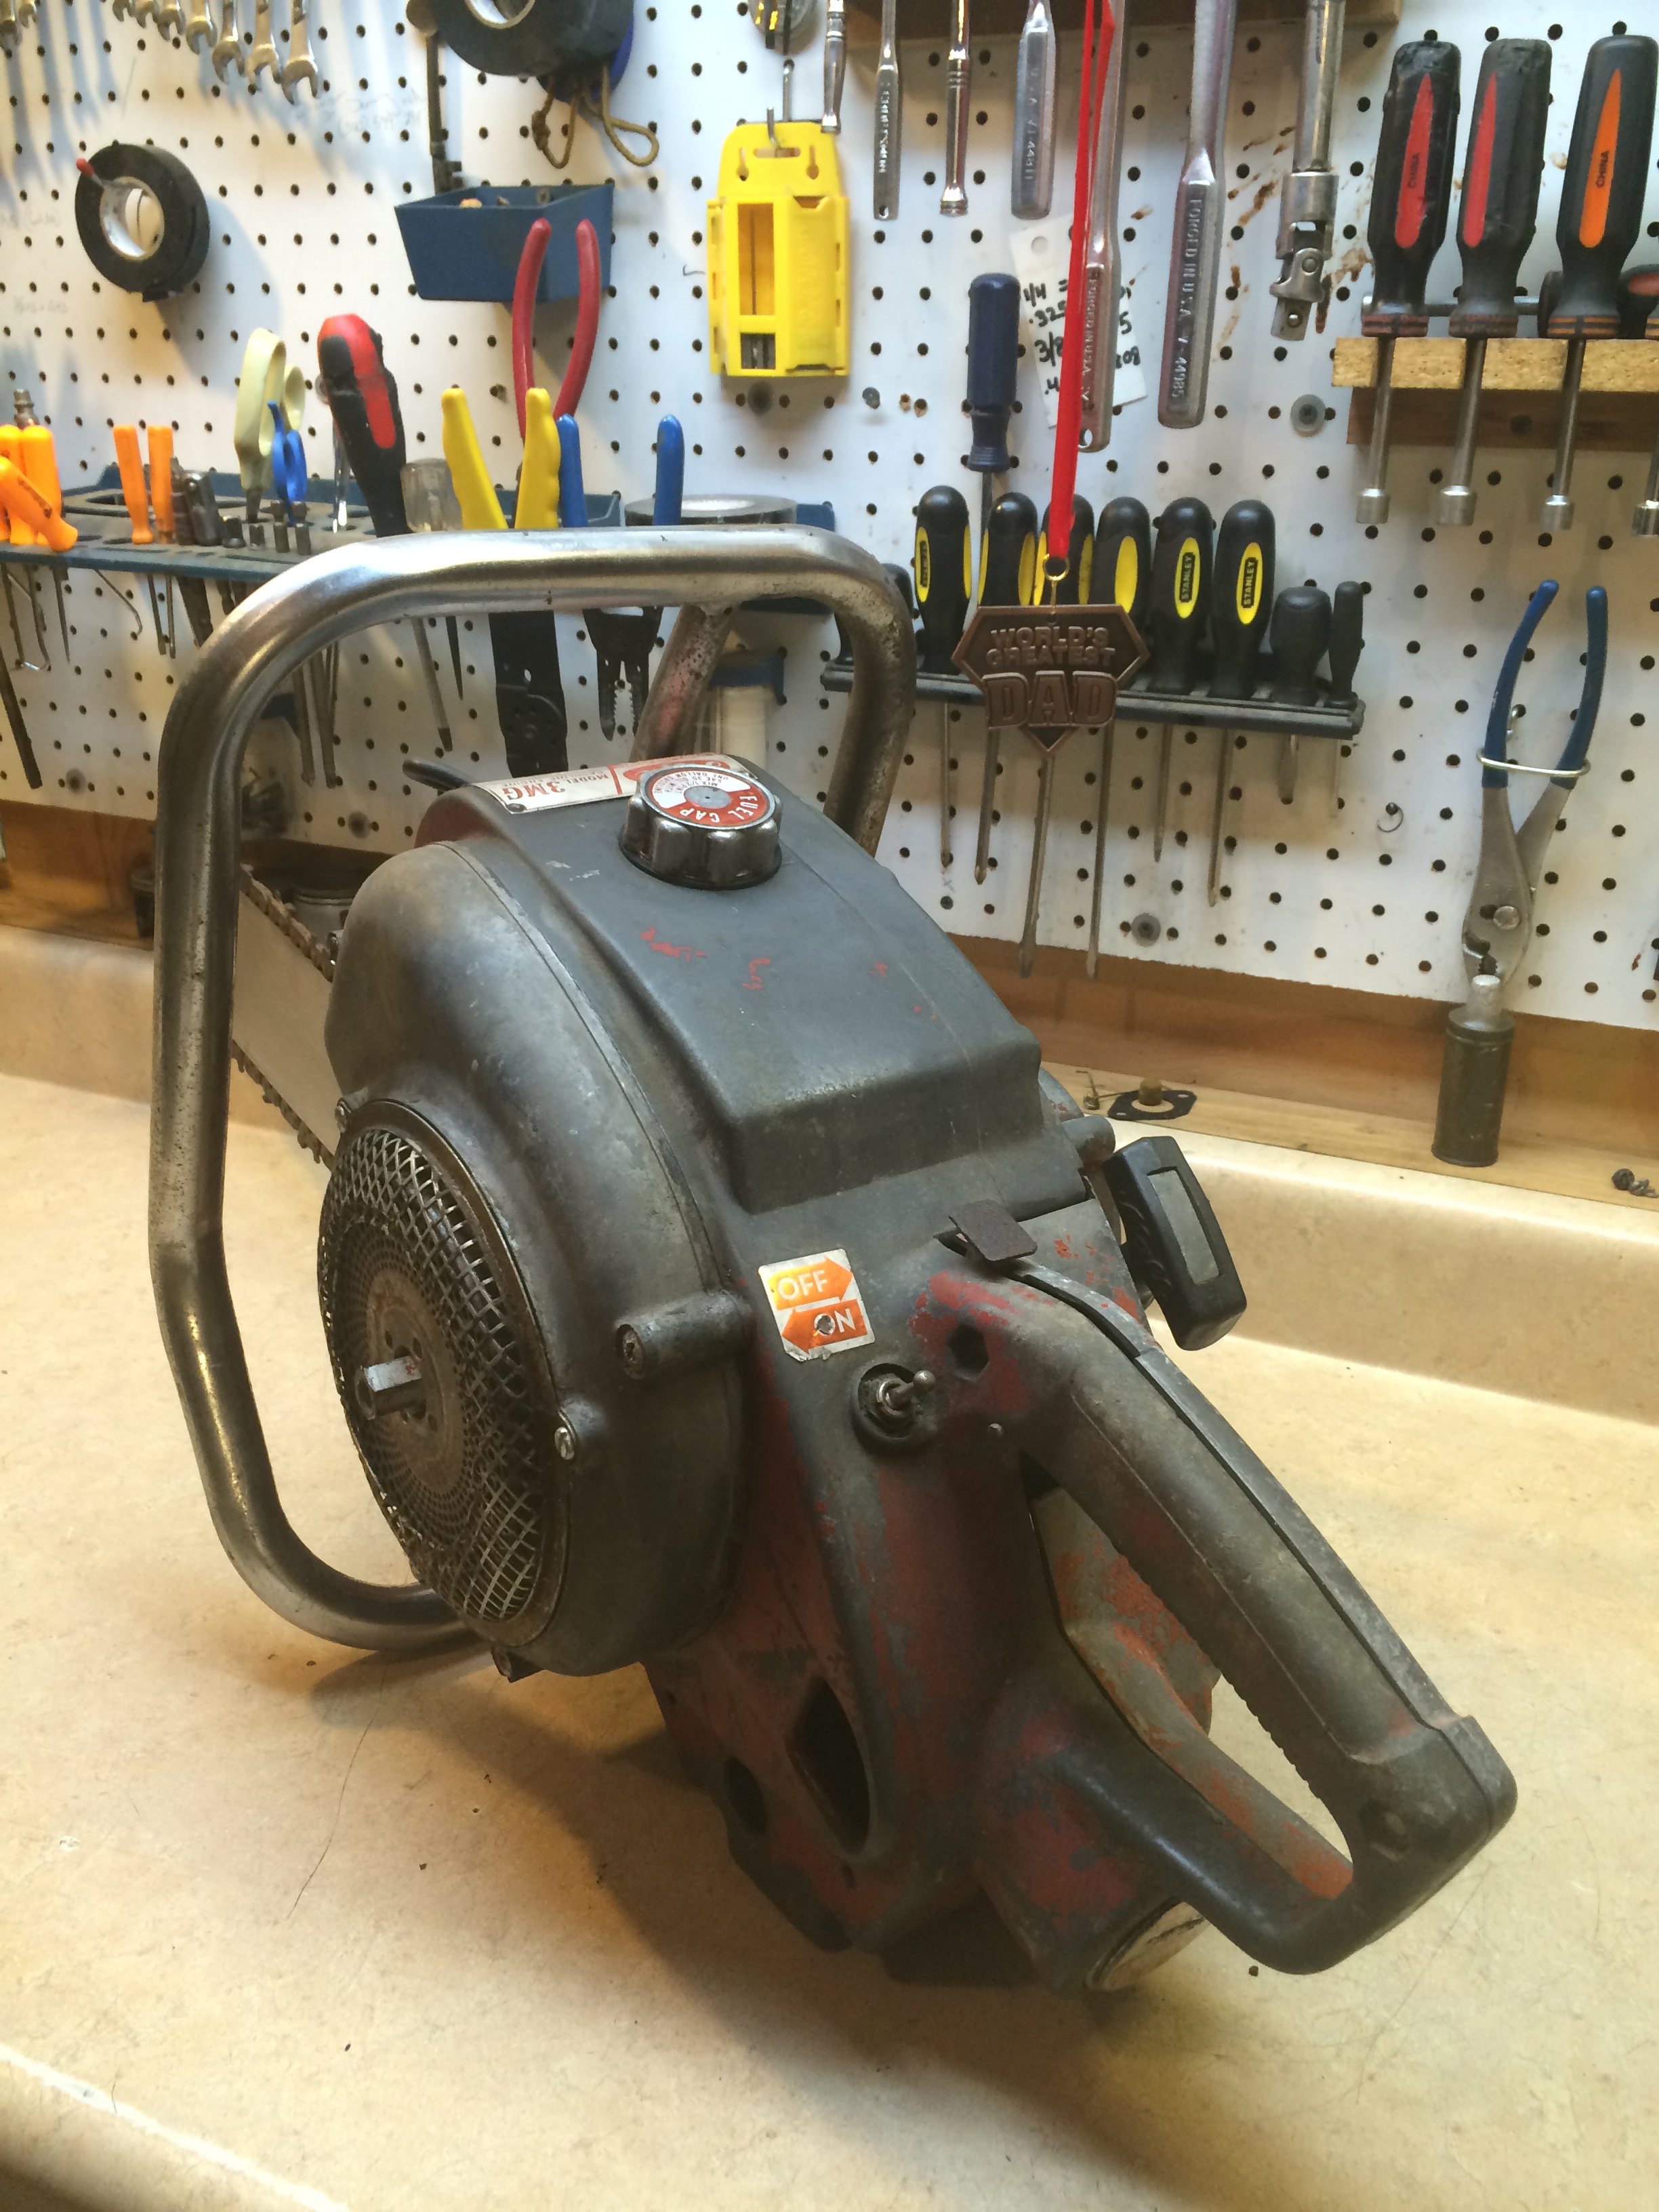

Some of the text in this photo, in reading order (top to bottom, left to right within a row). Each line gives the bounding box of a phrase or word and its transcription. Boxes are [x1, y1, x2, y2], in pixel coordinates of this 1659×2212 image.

[1595, 150, 1610, 188] CHINA
[1180, 554, 1194, 601] STANLEY
[1242, 559, 1255, 607] STANLEY
[990, 626, 1109, 648] WORLD'S
[986, 644, 1116, 667] GREATEST
[982, 670, 1118, 729] DAD
[502, 781, 566, 800] 3MG
[567, 773, 609, 784] MODEL
[679, 796, 759, 823] FUEL CAP
[777, 1269, 828, 1300] OFF
[813, 1307, 856, 1335] ON
